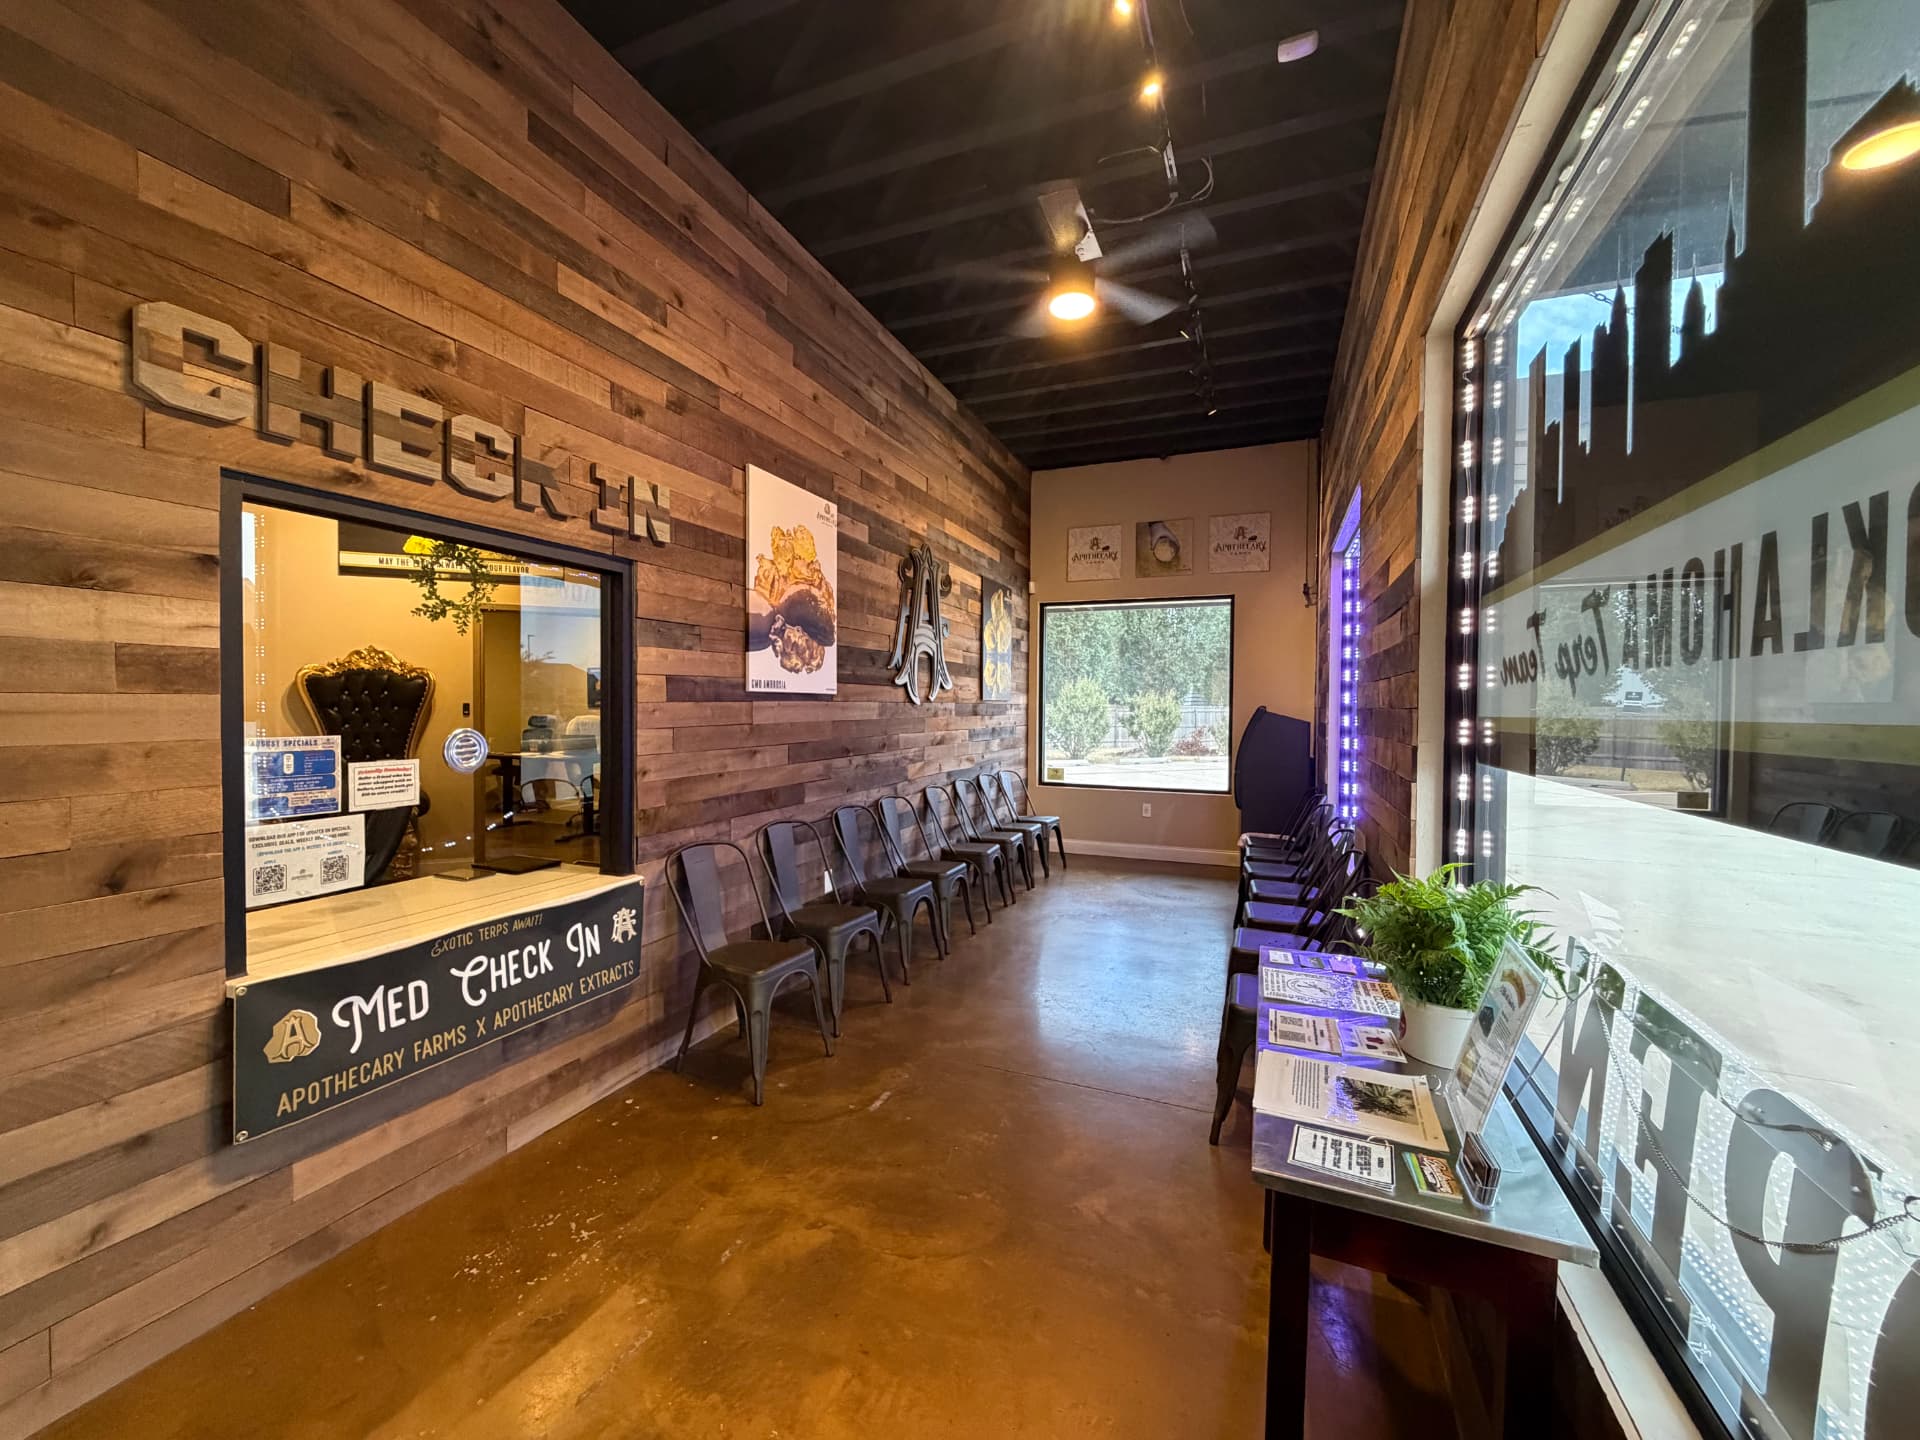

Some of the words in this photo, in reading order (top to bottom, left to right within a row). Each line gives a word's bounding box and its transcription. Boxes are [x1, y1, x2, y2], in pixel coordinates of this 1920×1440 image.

[132, 301, 573, 520] CHECK
[590, 462, 671, 547] IN
[378, 556, 394, 567] MAY
[396, 557, 412, 568] THE
[283, 738, 318, 748] SPECIALS
[430, 931, 473, 958] EXOTIC
[479, 922, 509, 942] TERPS
[512, 913, 543, 936] AWAIT!
[332, 980, 430, 1054] MED
[450, 939, 554, 1007] CHECK
[566, 922, 600, 967] IN
[277, 1048, 406, 1117] APOTHECARY
[414, 1024, 467, 1062] FARMS
[477, 1015, 487, 1040] X
[493, 982, 574, 1030] APOTHECARY
[580, 960, 634, 994] EXTRACTS
